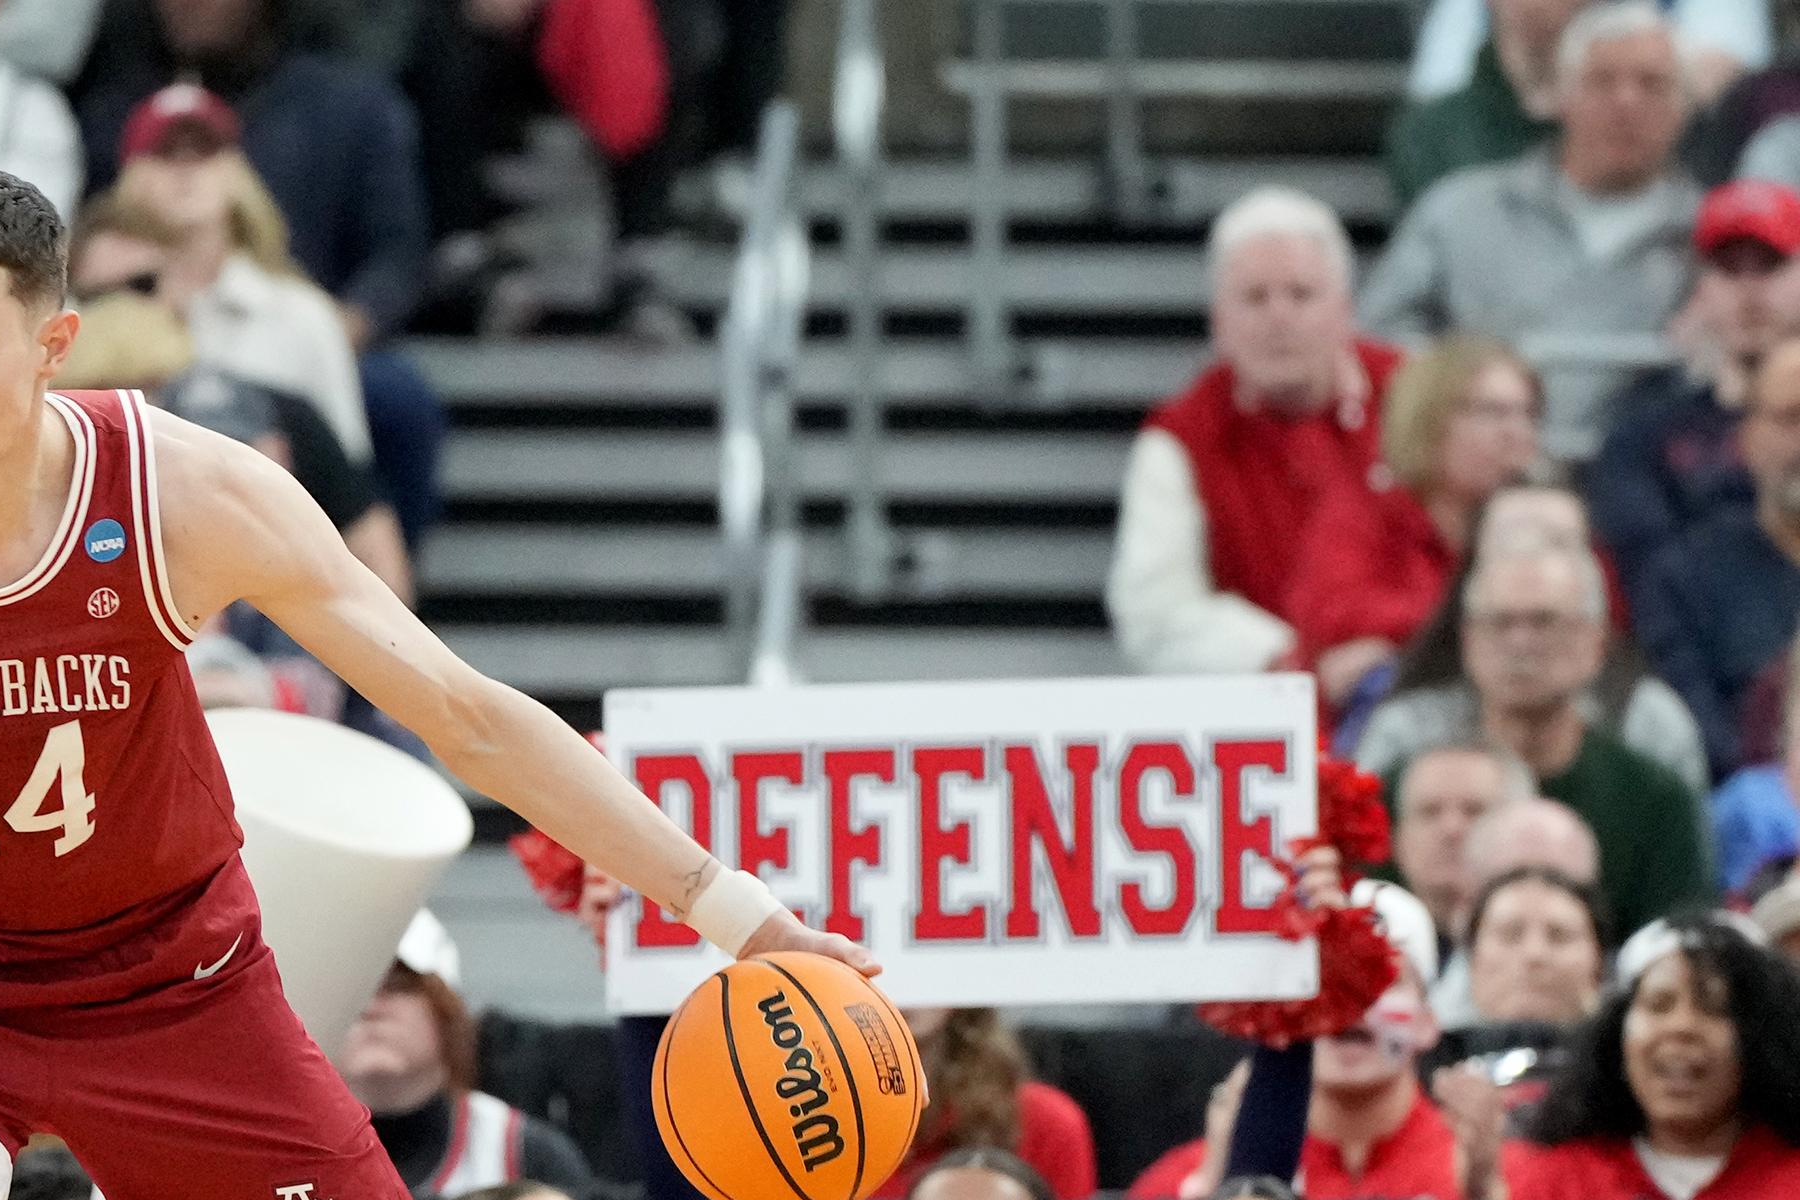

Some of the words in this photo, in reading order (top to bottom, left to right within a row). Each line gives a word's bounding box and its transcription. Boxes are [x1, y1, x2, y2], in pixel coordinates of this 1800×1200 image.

[89, 589, 118, 616] SEC
[628, 730, 1298, 950] DEFENSE
[758, 988, 845, 1173] Wilson
